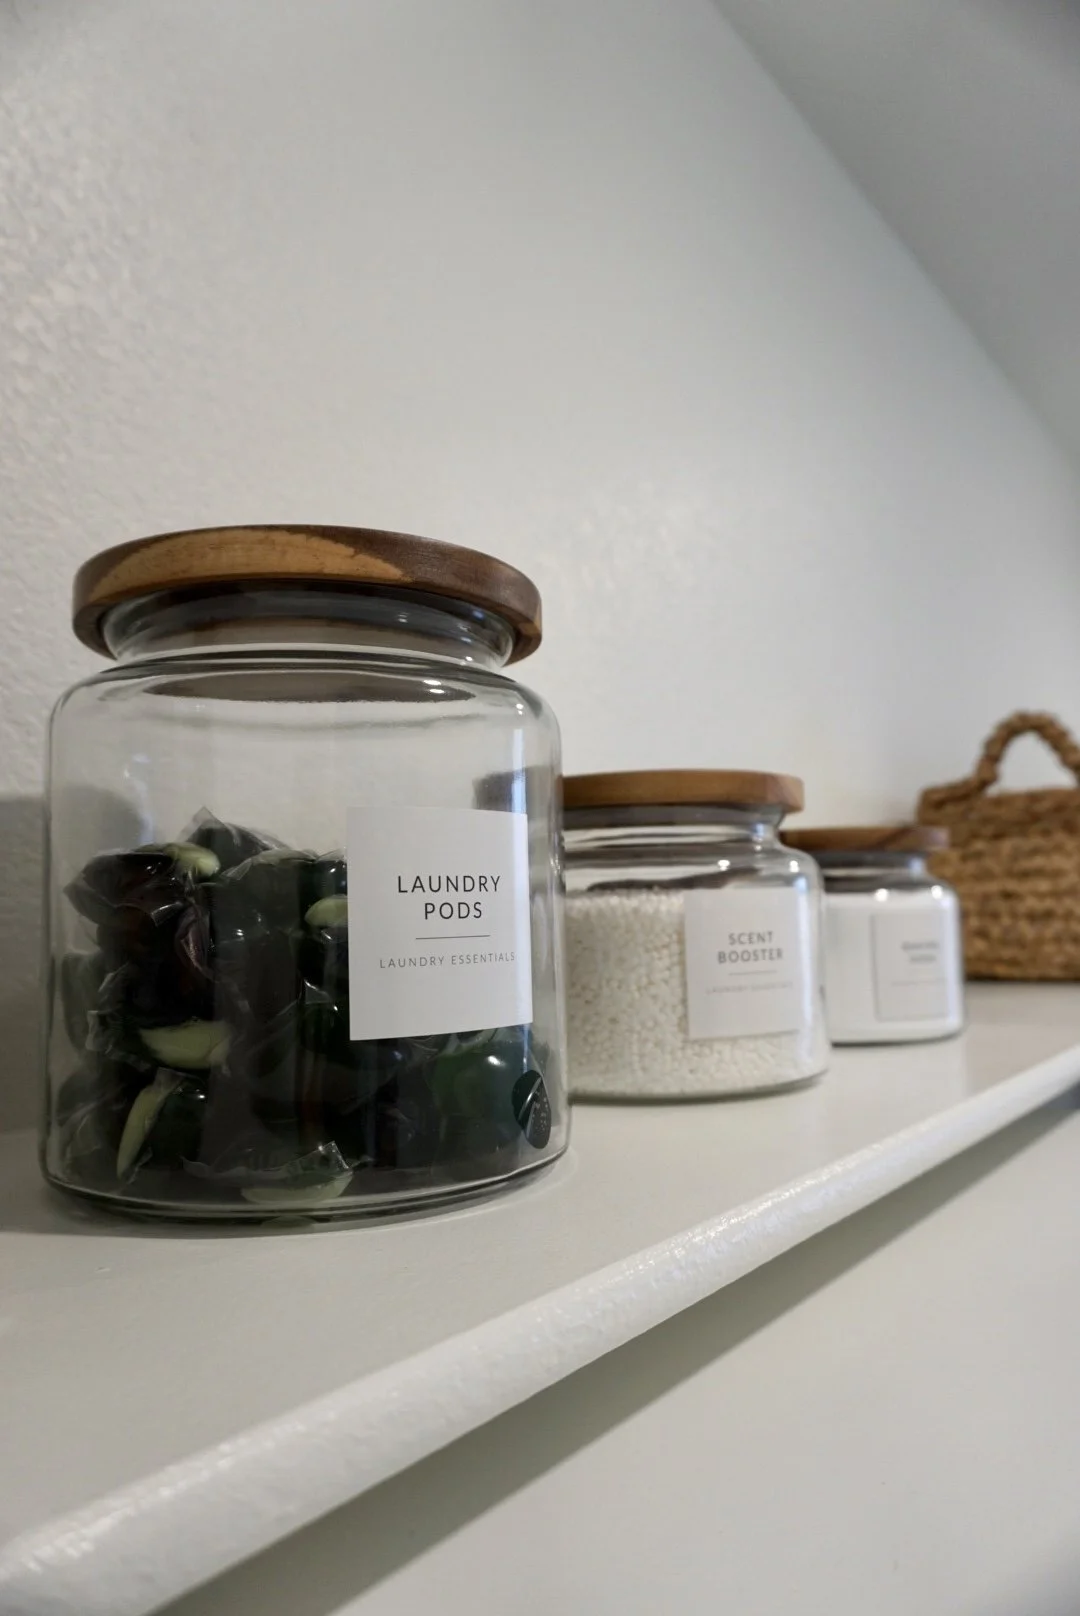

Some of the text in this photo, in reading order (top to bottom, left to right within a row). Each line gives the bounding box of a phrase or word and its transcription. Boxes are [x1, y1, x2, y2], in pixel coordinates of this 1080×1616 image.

[397, 875, 501, 893] LAUNDRY
[424, 901, 483, 920] PODS
[728, 930, 774, 946] SCENT
[379, 951, 515, 969] LAUNDRY ESSENTIALS
[717, 947, 783, 965] BOOSTER
